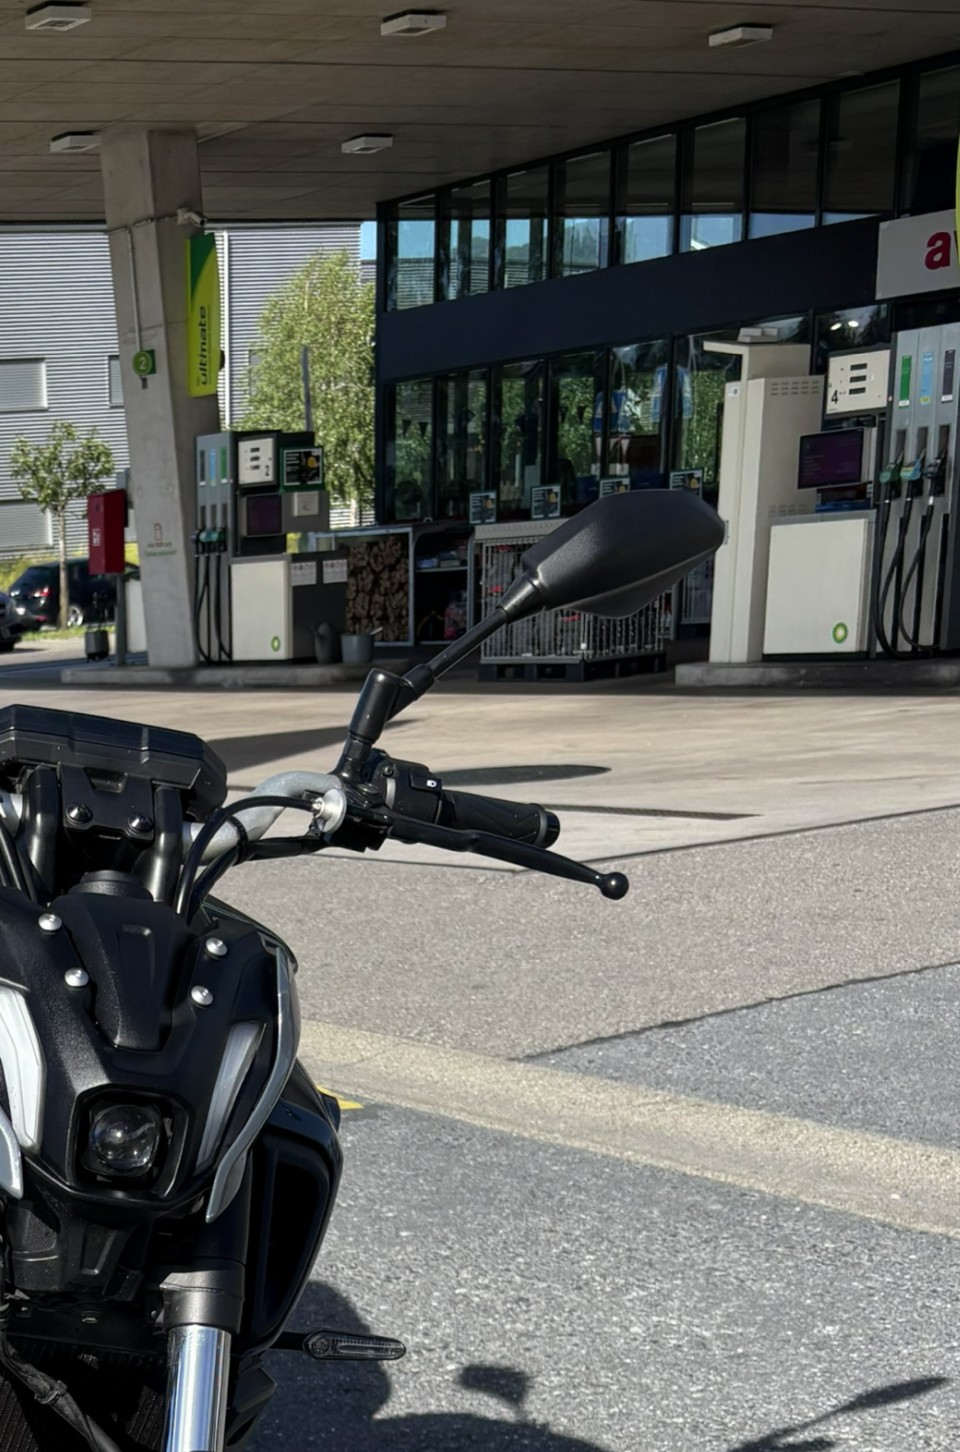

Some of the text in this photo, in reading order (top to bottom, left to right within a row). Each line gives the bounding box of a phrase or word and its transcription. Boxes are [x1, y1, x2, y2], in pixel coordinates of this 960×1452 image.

[925, 231, 958, 270] a
[199, 306, 207, 385] ultimate
[139, 357, 146, 370] 2
[831, 389, 838, 405] 4
